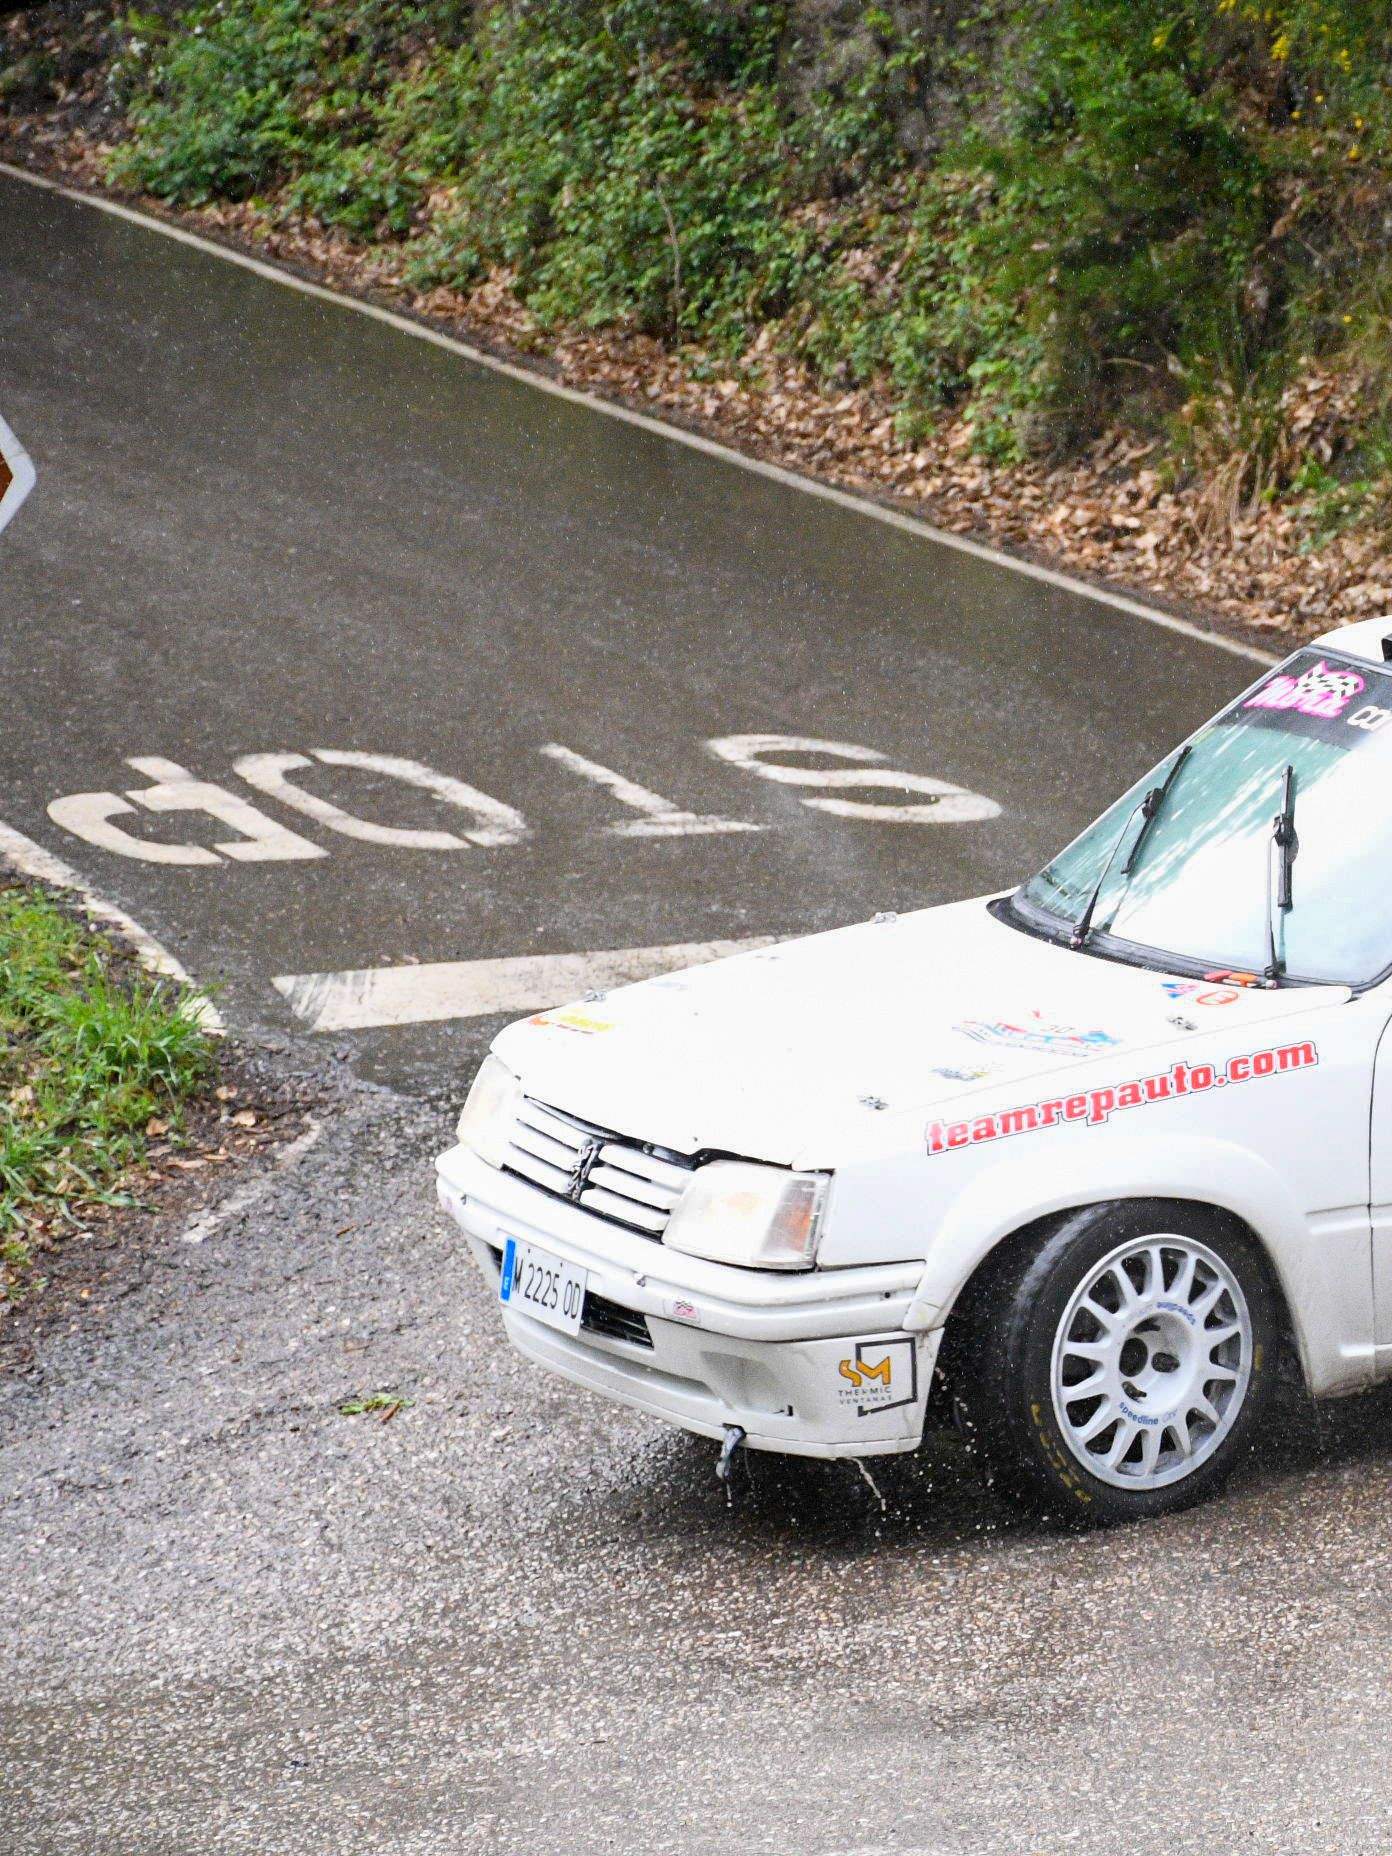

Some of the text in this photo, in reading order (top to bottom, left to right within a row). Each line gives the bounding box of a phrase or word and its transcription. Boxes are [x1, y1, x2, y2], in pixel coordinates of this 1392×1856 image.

[45, 733, 1004, 866] STOP
[928, 1041, 1318, 1155] teamrepauto.com
[524, 1263, 560, 1310] 2225
